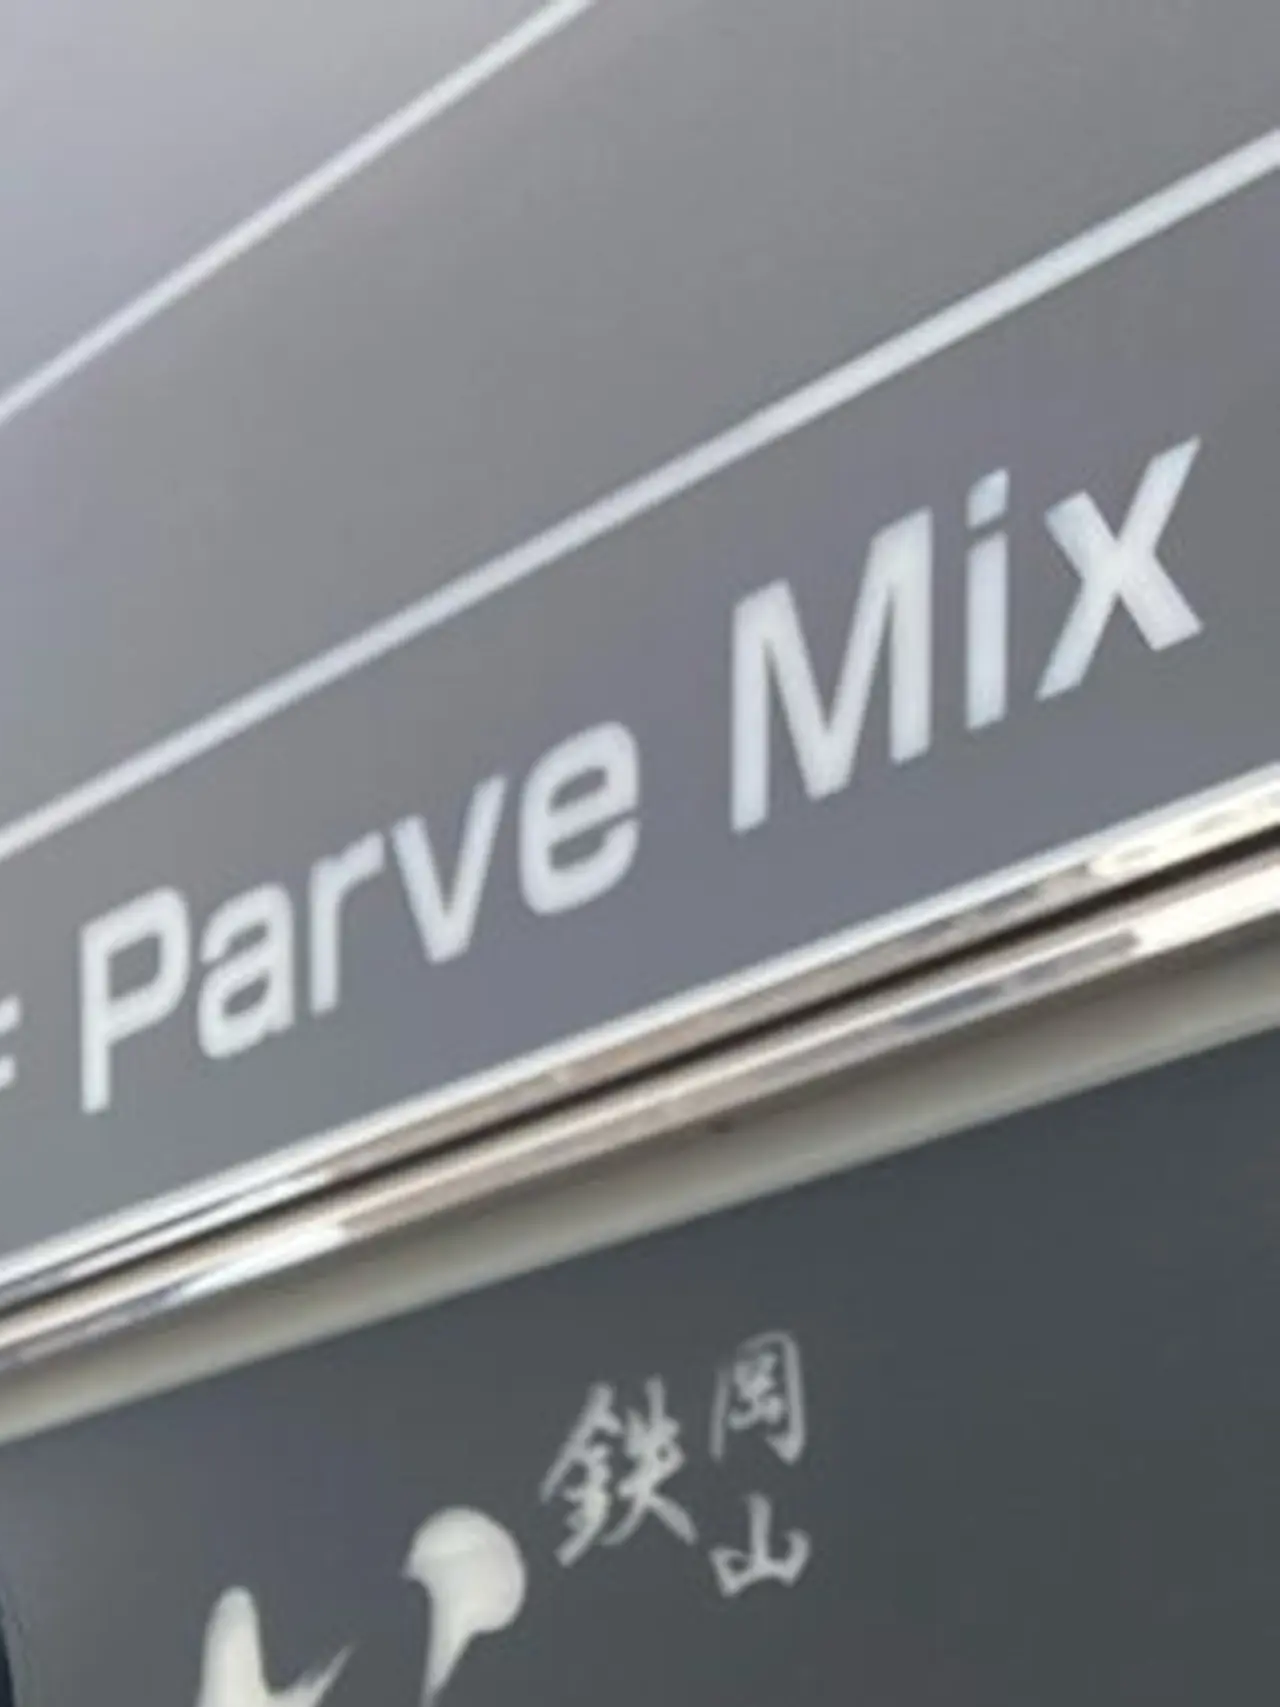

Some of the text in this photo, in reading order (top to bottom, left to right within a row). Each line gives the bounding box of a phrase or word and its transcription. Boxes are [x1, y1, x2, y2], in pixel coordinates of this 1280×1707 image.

[78, 720, 642, 1116] Parve
[728, 435, 1206, 833] Mix
[707, 1331, 811, 1598] 岡山
